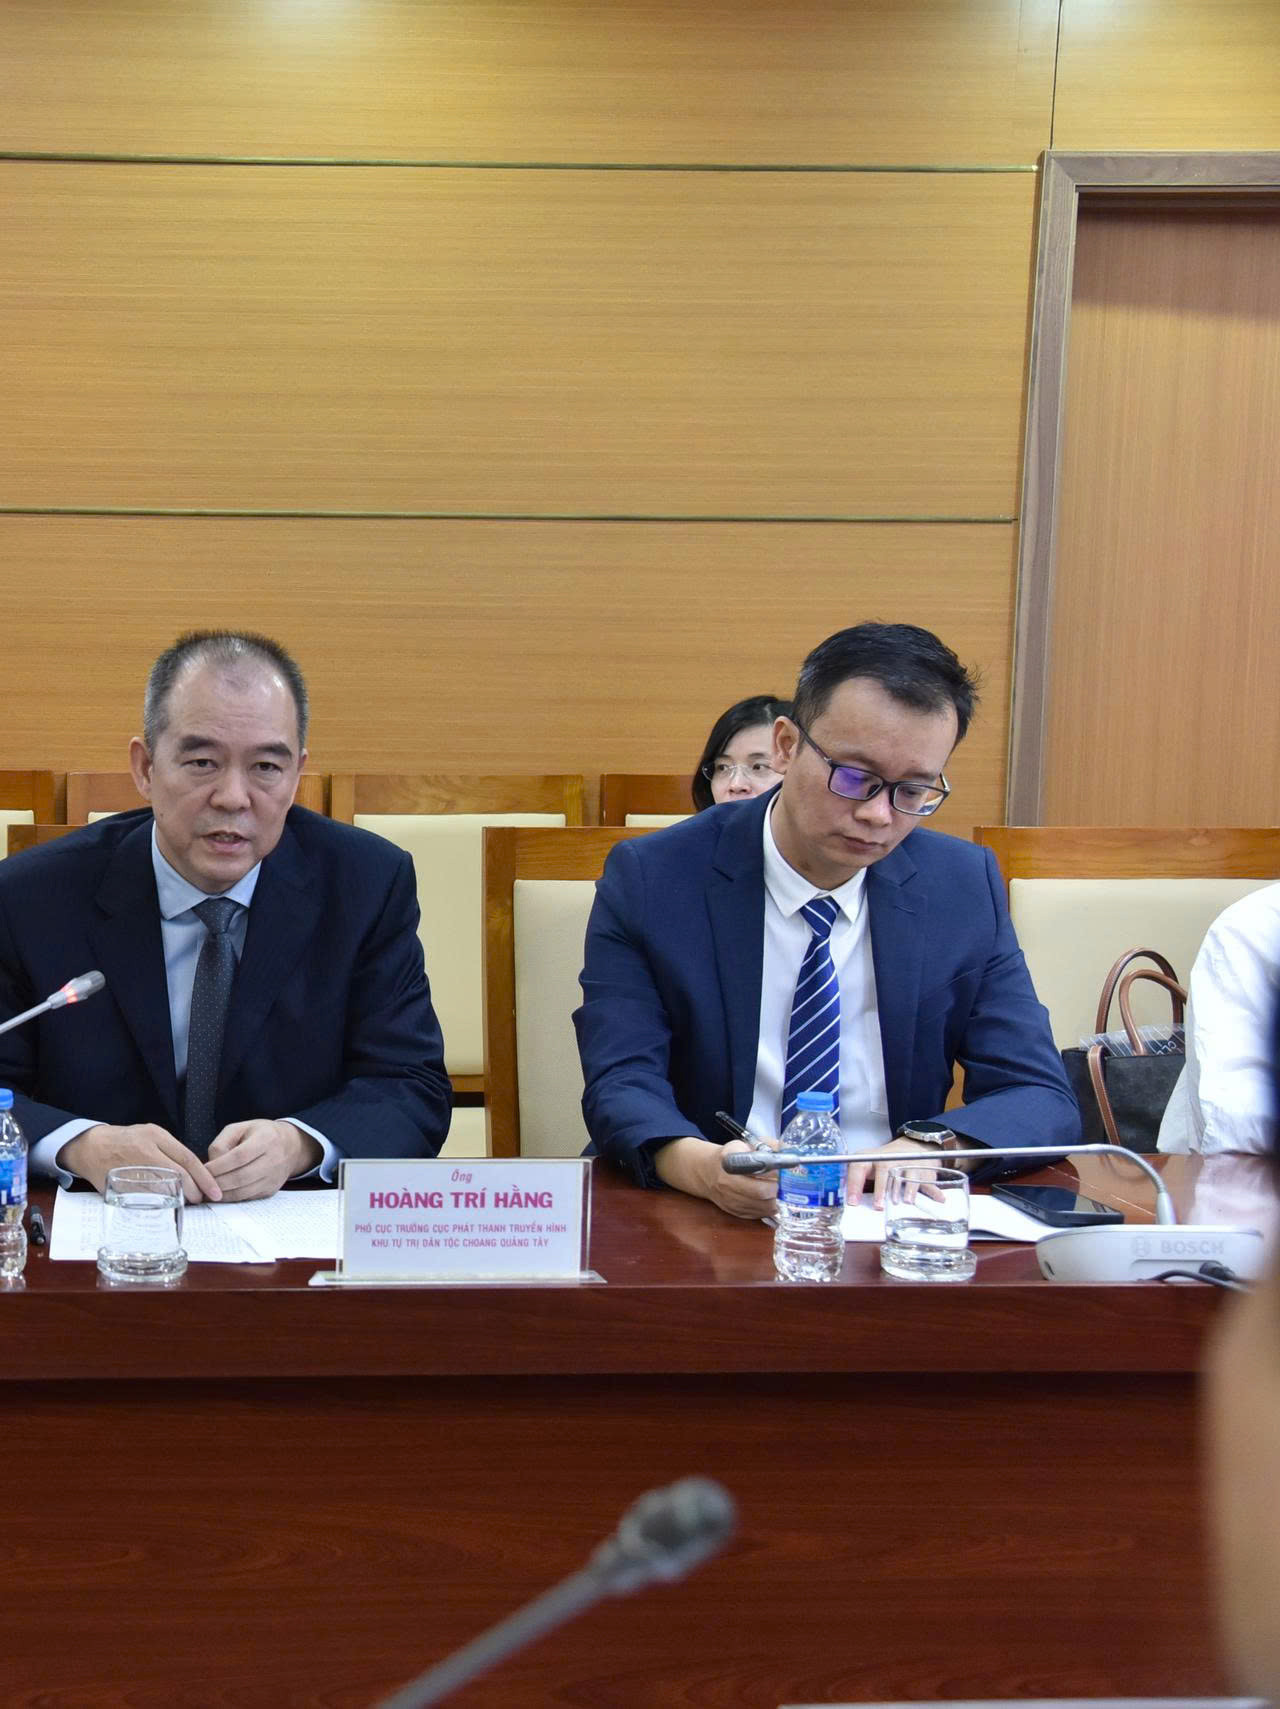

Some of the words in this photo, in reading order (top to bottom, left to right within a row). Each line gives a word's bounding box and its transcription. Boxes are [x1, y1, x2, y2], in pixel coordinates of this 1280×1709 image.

[451, 1168, 473, 1184] Ông
[369, 1187, 443, 1209] HOÀNG
[450, 1187, 487, 1209] TRÍ
[494, 1184, 553, 1209] HẰNG
[354, 1222, 372, 1233] PHÓ
[375, 1224, 392, 1234] CỤC
[432, 1224, 450, 1234] CỤC
[452, 1222, 475, 1233] PHÁT
[478, 1223, 506, 1233] THANH
[546, 1222, 567, 1233] HÌNH
[371, 1238, 389, 1248] KHU
[406, 1238, 420, 1249] TRỊ
[1160, 1239, 1224, 1255] BOSCH
